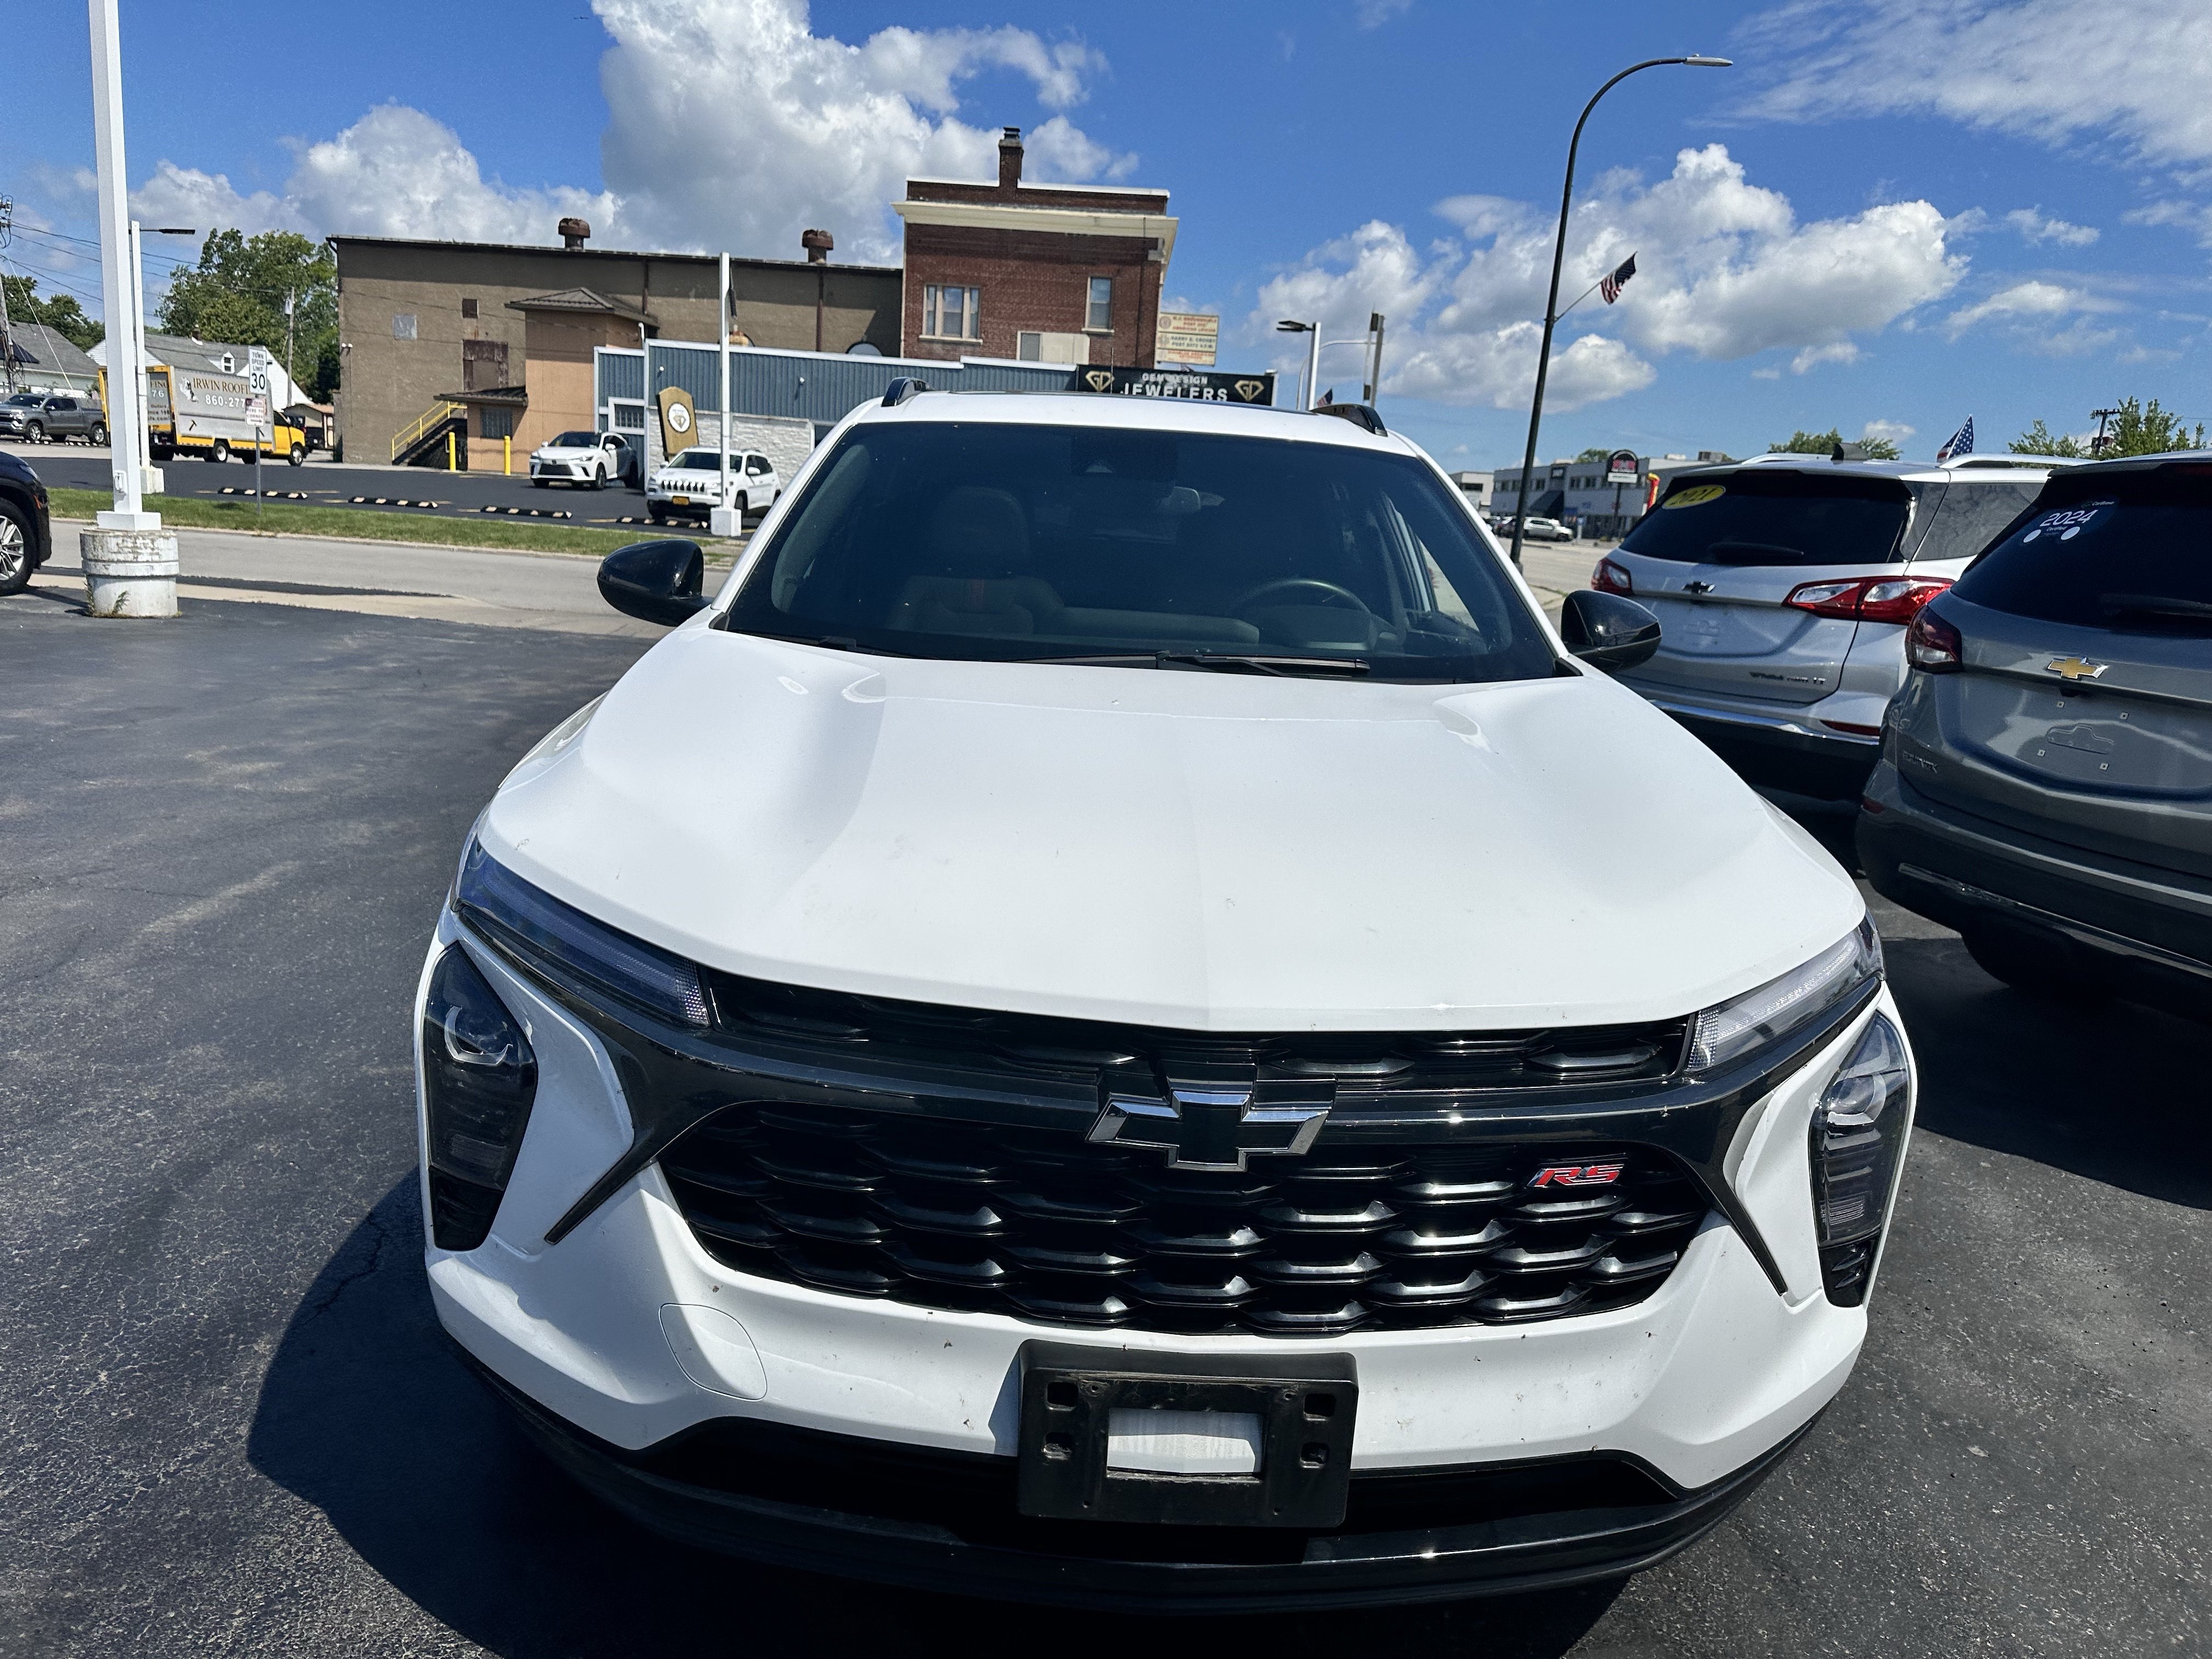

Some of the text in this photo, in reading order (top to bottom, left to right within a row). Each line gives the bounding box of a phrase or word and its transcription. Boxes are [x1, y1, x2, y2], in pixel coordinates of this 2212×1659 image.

[193, 377, 251, 395] IRWIN ROOFI
[251, 373, 266, 390] 30
[205, 394, 246, 408] 860-277
[1120, 383, 1228, 402] JEWELERS
[2039, 509, 2099, 527] 2024
[1527, 1164, 1624, 1187] RS
